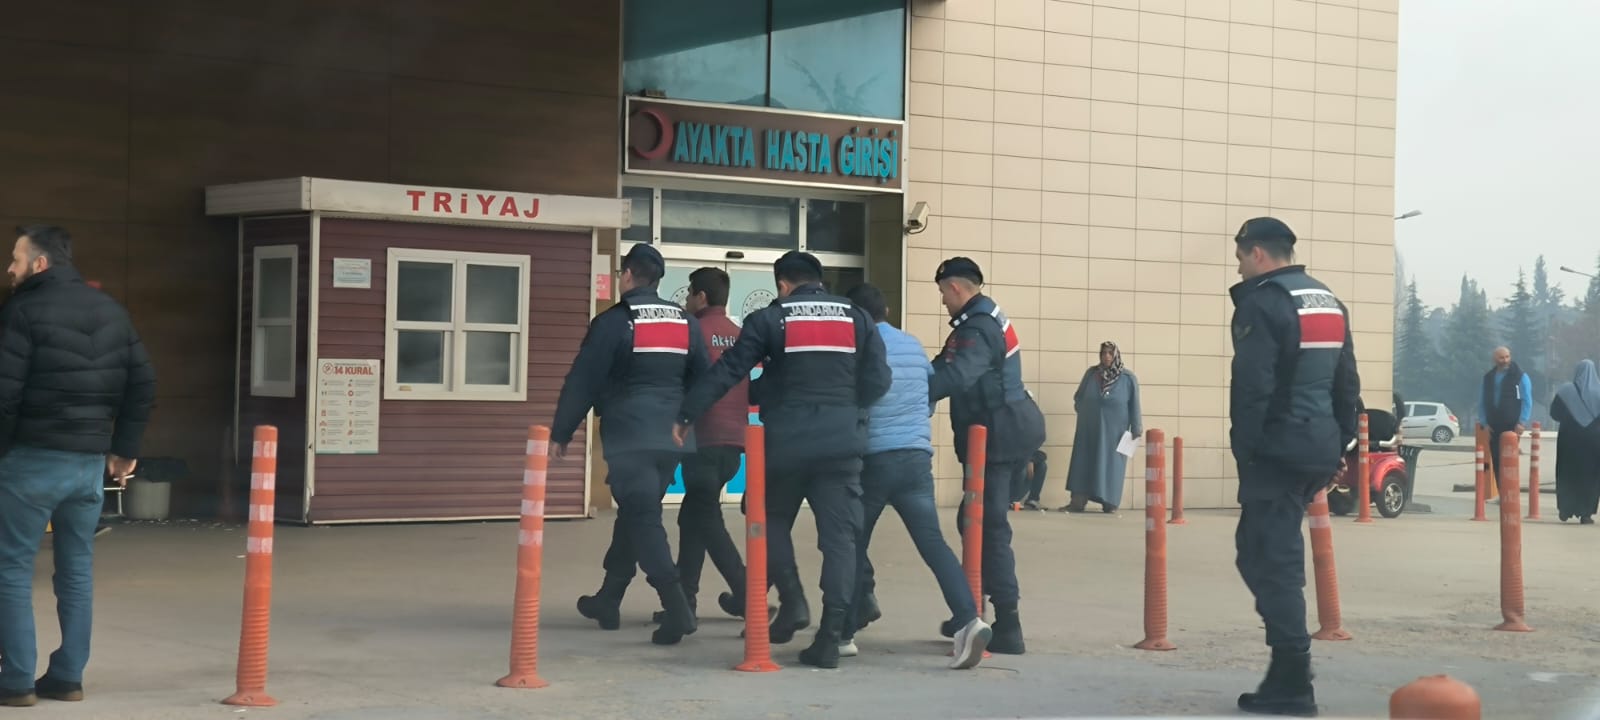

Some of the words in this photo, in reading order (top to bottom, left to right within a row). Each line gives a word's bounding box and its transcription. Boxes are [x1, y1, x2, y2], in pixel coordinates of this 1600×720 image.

[673, 120, 757, 168] AYAKTA
[764, 128, 833, 174] HASTA
[838, 126, 899, 185] GİRİŞİ
[637, 308, 682, 320] JANDARMA
[789, 305, 847, 317] JANDARMA
[345, 366, 374, 376] KURAL
